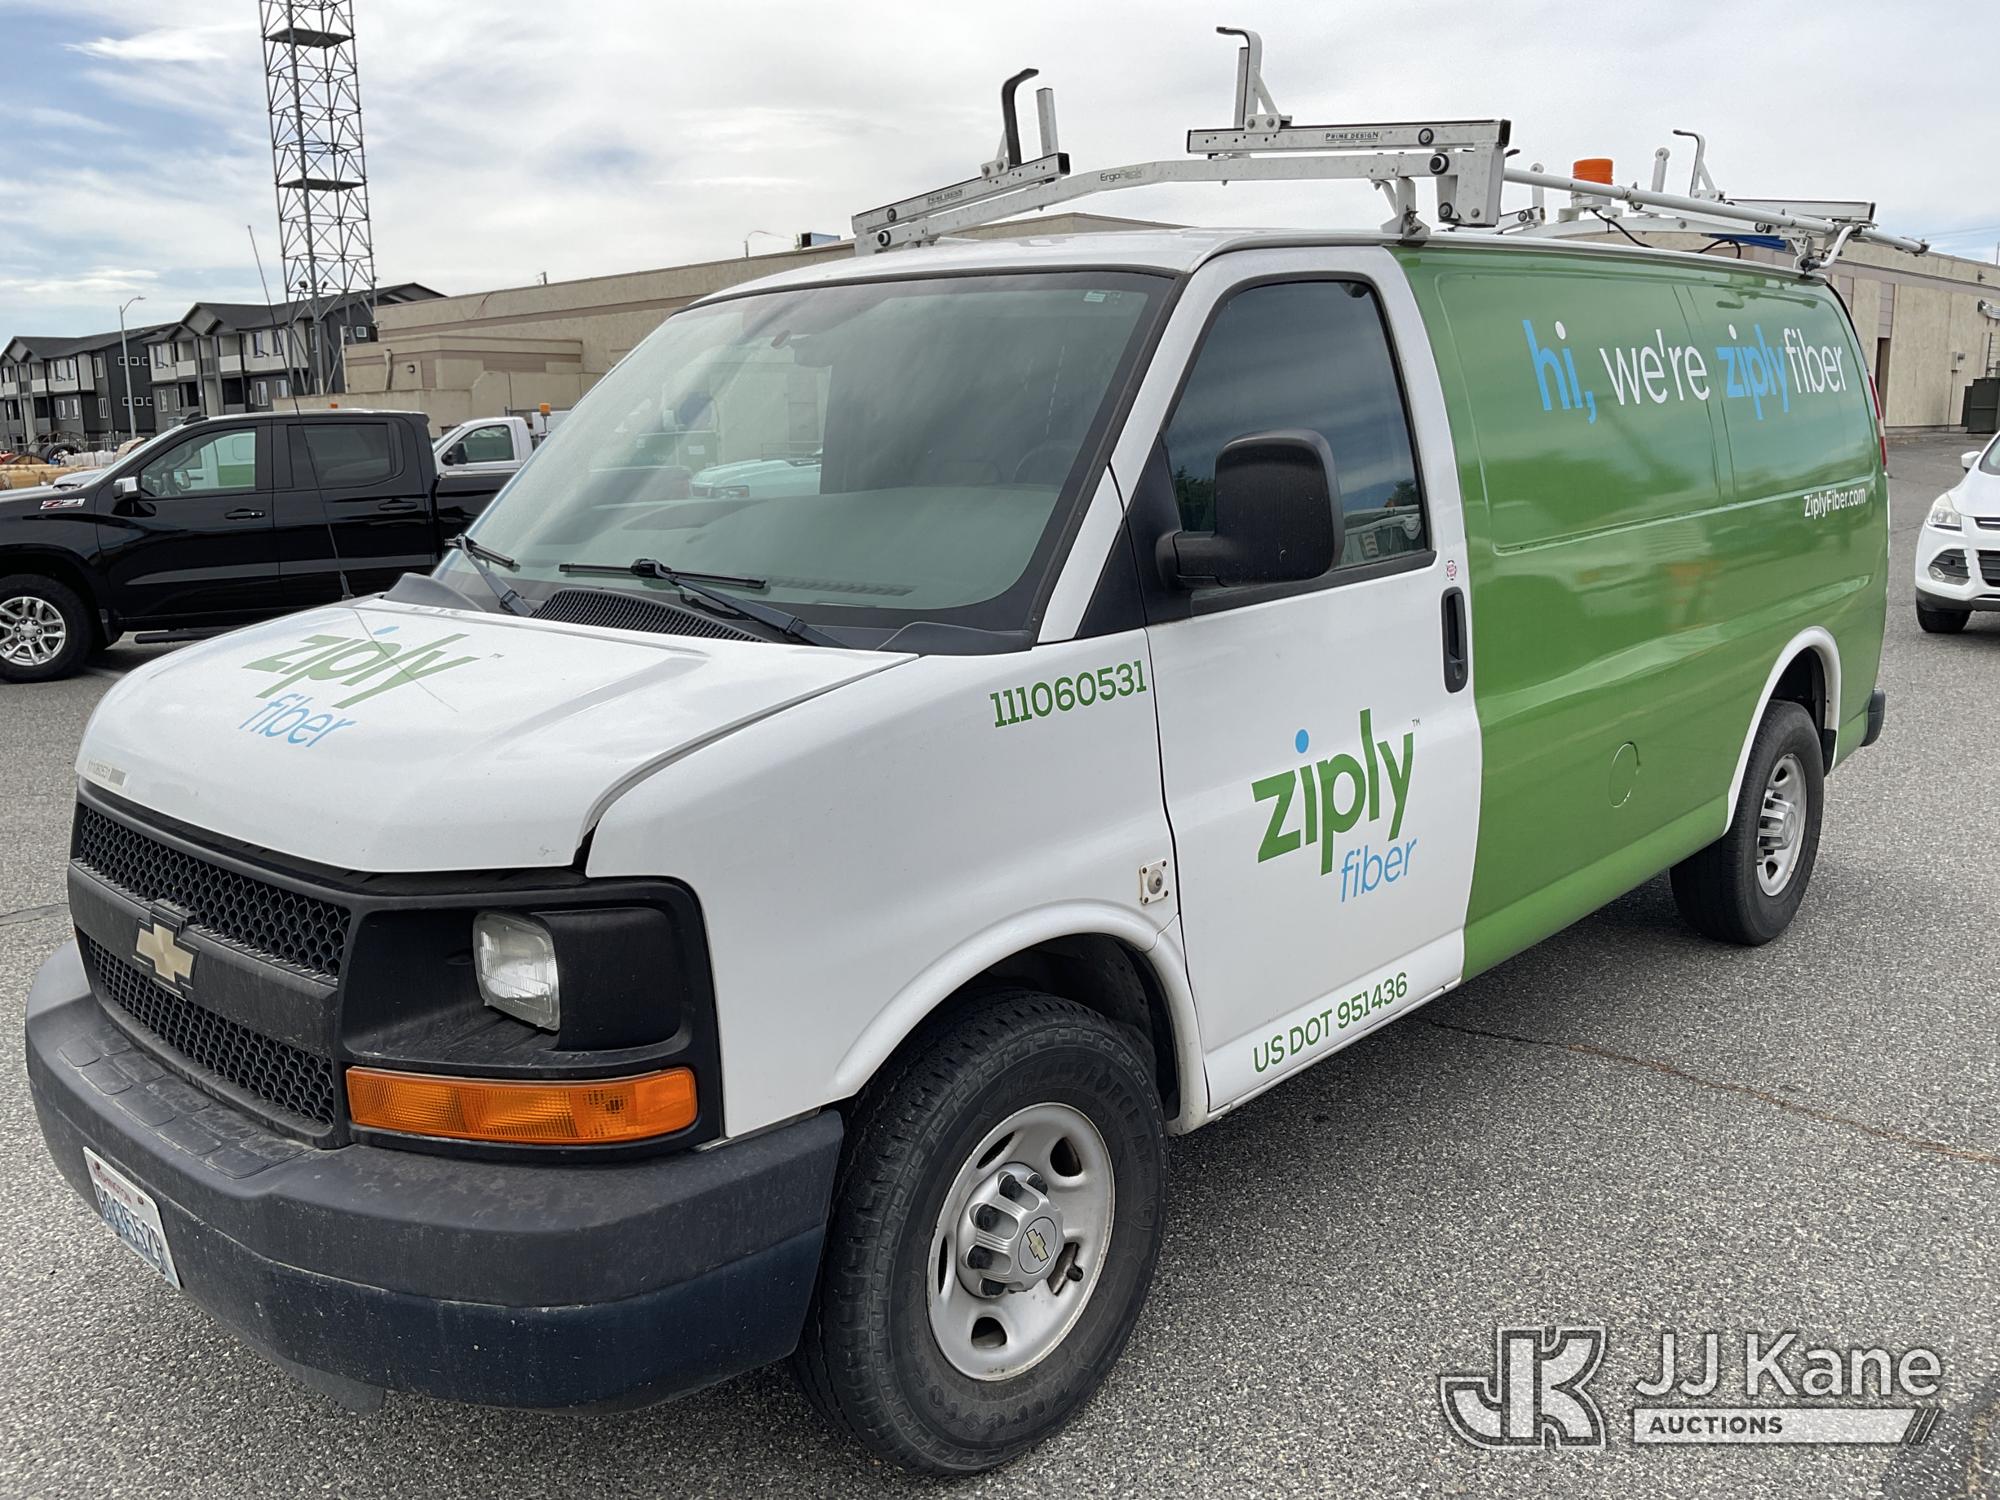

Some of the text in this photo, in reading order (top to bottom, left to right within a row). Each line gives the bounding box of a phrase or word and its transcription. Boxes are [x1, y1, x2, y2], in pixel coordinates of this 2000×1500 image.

[1325, 131, 1379, 140] PRIME DESIGN
[1522, 319, 1597, 424] hi,
[1599, 328, 1711, 406] we're
[1803, 487, 1867, 520] ZiplyFiber.com
[241, 626, 480, 709] ziply
[990, 660, 1147, 728] 111060531
[238, 693, 357, 747] fiber
[1251, 708, 1414, 876] ziply
[1341, 838, 1418, 902] fiber
[1253, 971, 1408, 1073] US DOT 951436
